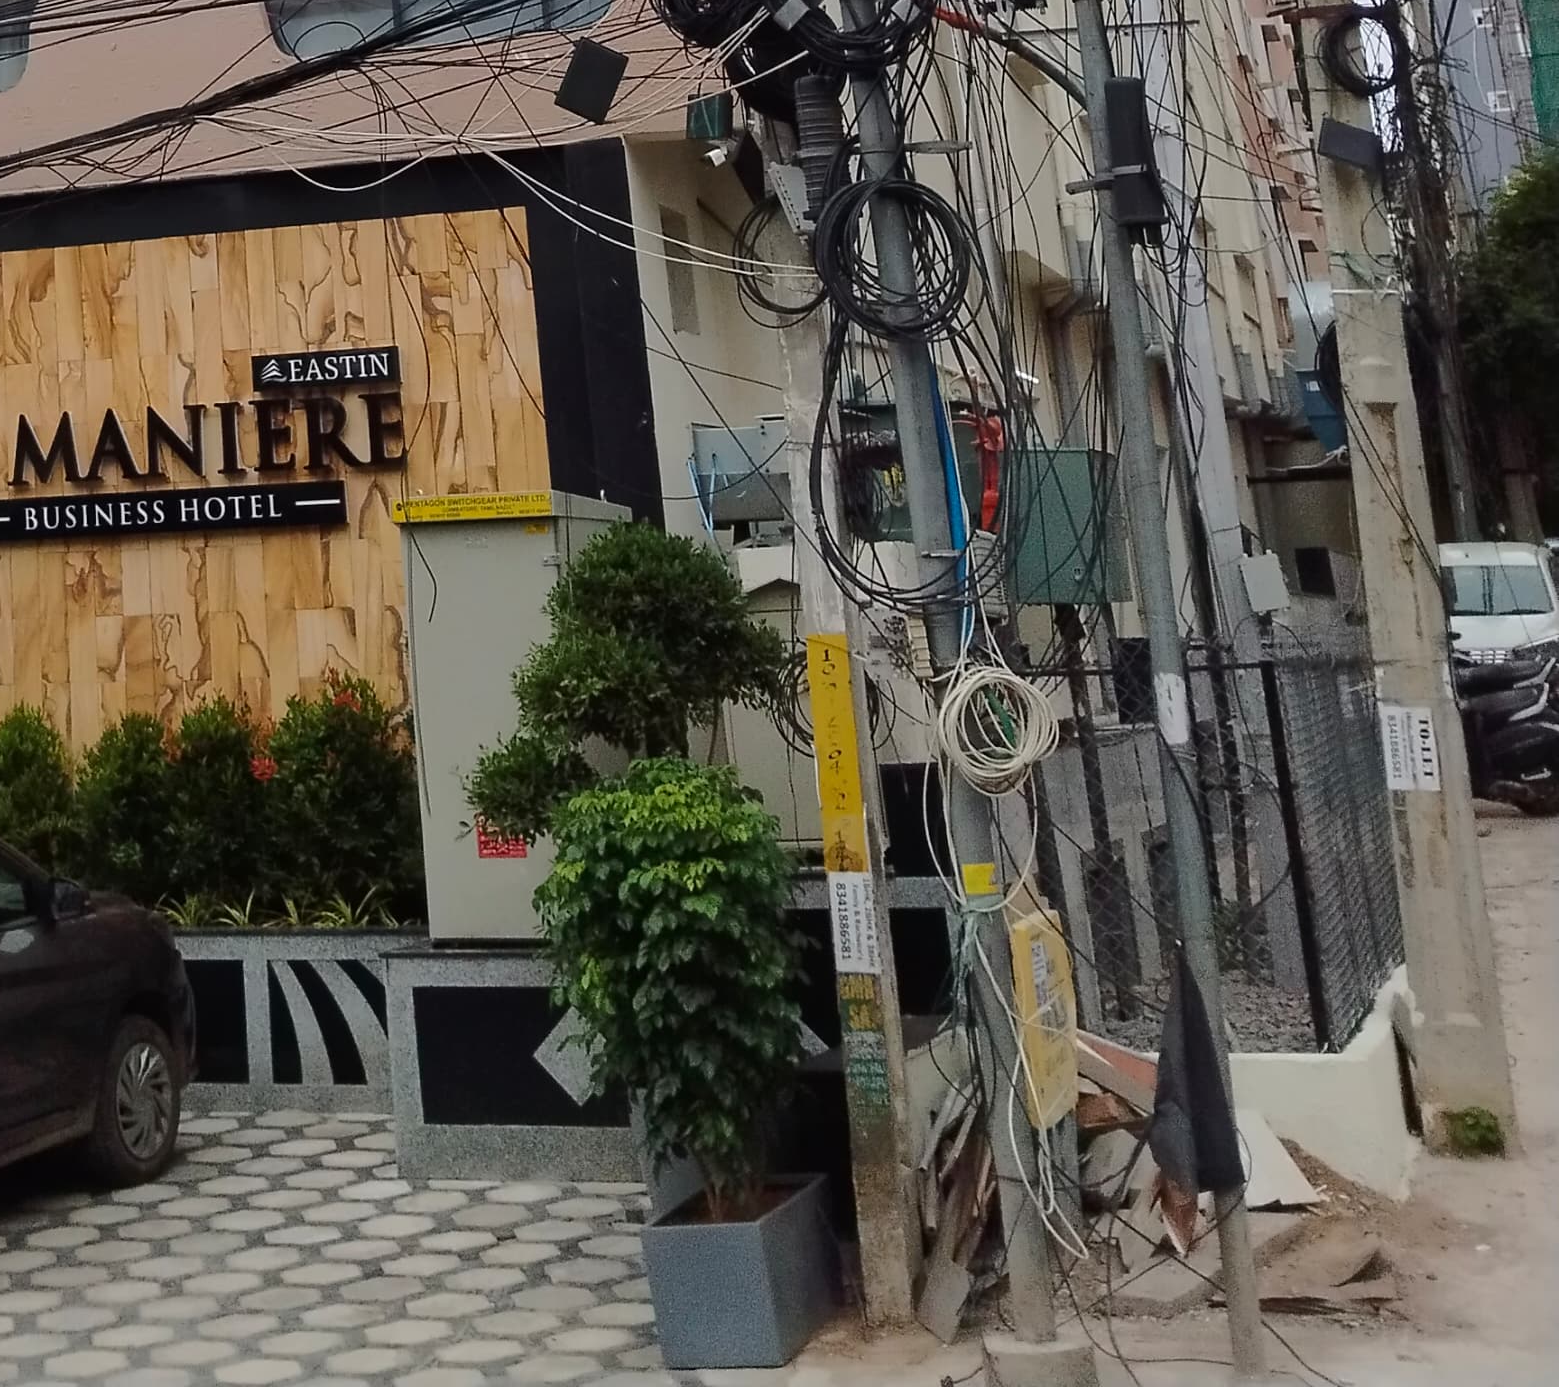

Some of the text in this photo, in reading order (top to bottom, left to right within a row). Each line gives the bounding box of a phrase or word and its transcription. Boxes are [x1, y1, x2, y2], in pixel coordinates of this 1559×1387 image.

[288, 352, 390, 383] EASTIN
[7, 391, 408, 487] MANIERE
[24, 493, 282, 531] BUSINESS HOTEL
[835, 882, 852, 961] 8341886581
